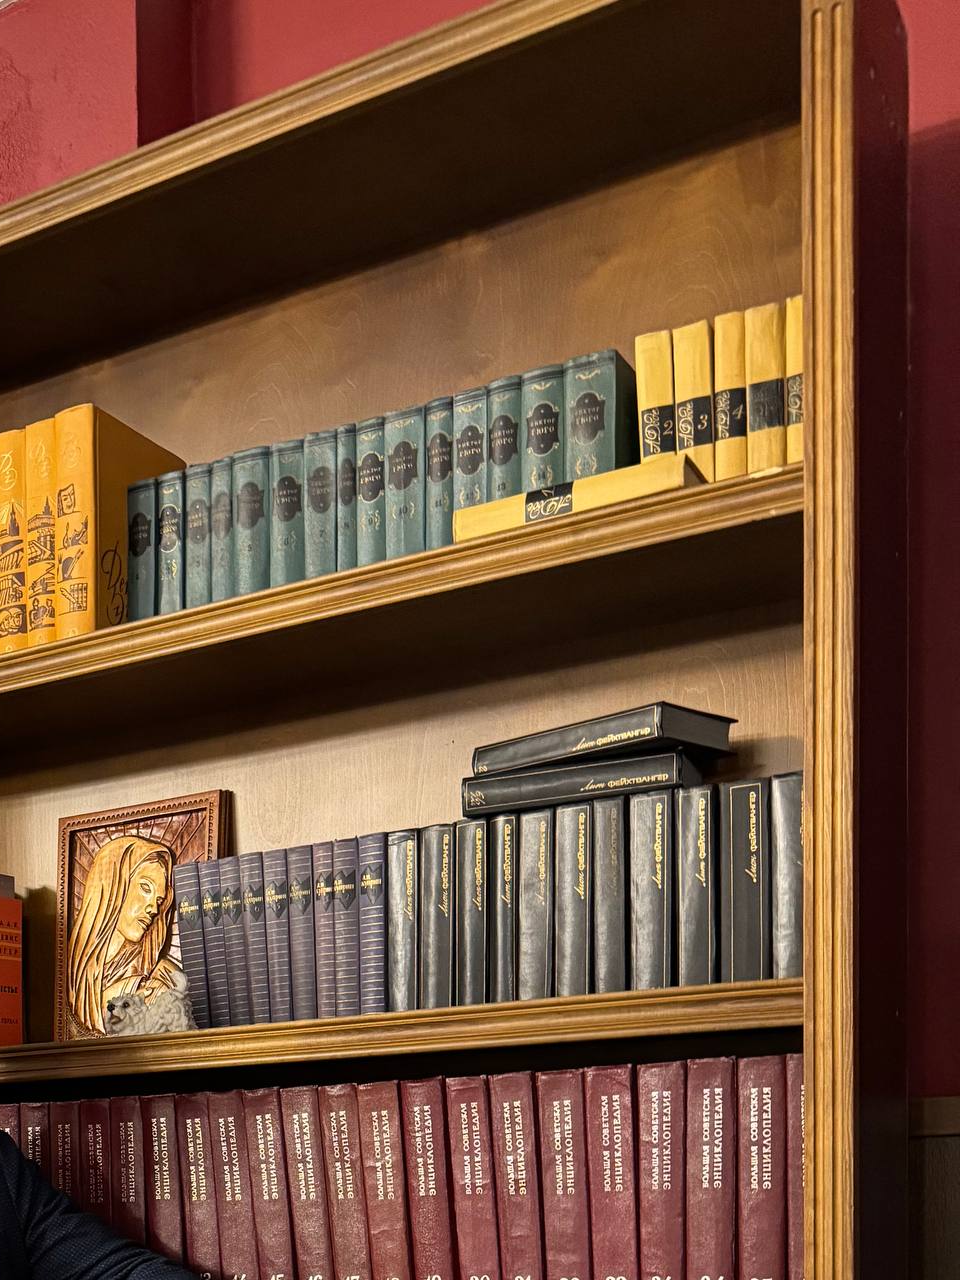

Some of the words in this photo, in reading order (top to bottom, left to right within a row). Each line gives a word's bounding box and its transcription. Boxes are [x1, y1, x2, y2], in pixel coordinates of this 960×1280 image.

[663, 420, 673, 436] 2
[697, 414, 708, 430] 3
[732, 404, 744, 419] 4
[596, 727, 651, 746] ФЕЙХТВАНГЕР
[607, 773, 669, 788] ФЕЙХТВАНГЕР
[577, 812, 585, 871] ФЕЙХТВАНГЕР
[654, 802, 663, 863] ФЕЙХТВАНГЕР
[697, 797, 706, 859] ФЕЙХТВАНГЕР
[748, 791, 758, 852] ФЕЙХТВАНГЕР
[255, 1115, 266, 1159] СОВЕТСКАЯ
[292, 1114, 303, 1160] СОВЕТСКАЯ
[329, 1111, 340, 1158] СОВЕТСКАЯ
[371, 1111, 380, 1158] СОВЕТСКАЯ
[413, 1106, 423, 1154] СОВЕТСКАЯ
[460, 1102, 470, 1152] СОВЕТСКАЯ
[503, 1102, 513, 1151] СОВЕТСКАЯ
[553, 1101, 562, 1151] СОВЕТСКАЯ
[601, 1095, 610, 1147] СОВЕТСКАЯ
[651, 1091, 659, 1144] СОВЕТСКАЯ
[702, 1088, 710, 1142] СОВЕТСКАЯ
[713, 1087, 723, 1189] ЭНЦИКЛОПЕДИЯ
[750, 1087, 759, 1142] СОВЕТСКАЯ
[762, 1087, 772, 1189] ЭНЦИКЛОПЕДИЯ
[151, 1118, 159, 1162] СОВЕТСКАЯ
[160, 1117, 171, 1200] ЭНЦИКЛОПЕДИЯ
[185, 1119, 195, 1162] СОВЕТСКАЯ
[194, 1118, 207, 1201] ЭНЦИКЛОПЕДИЯ
[218, 1118, 229, 1162] СОВЕТСКАЯ
[227, 1116, 241, 1201] ЭНЦИКЛОПЕДИЯ
[264, 1113, 279, 1200] ЭНЦИКЛОПЕДИЯ
[301, 1112, 316, 1200] ЭНЦИКЛОПЕДИЯ
[339, 1110, 354, 1199] ЭНЦИКЛОПЕДИЯ
[381, 1110, 395, 1200] ЭНЦИКЛОПЕДИЯ
[423, 1105, 436, 1196] ЭНЦИКЛОПЕДИЯ
[470, 1102, 483, 1195] ЭНЦИКЛОПЕДИЯ
[513, 1100, 527, 1195] ЭНЦИКЛОПЕДИЯ
[563, 1100, 575, 1195] ЭНЦИКЛОПЕДИЯ
[612, 1094, 623, 1192] ЭНЦИКЛОПЕДИЯ
[662, 1090, 672, 1190] ЭНЦИКЛОПЕДИЯ
[190, 1165, 198, 1201] БОЛЬШАЯ
[223, 1165, 232, 1201] БОЛЬШАЯ
[260, 1163, 270, 1200] БОЛЬШАЯ
[297, 1162, 306, 1200] БОЛЬШАЯ
[335, 1161, 344, 1200] БОЛЬШАЯ
[375, 1162, 384, 1200] БОЛЬШАЯ
[417, 1157, 426, 1197] БОЛЬШАЯ
[463, 1155, 472, 1195] БОЛЬШАЯ
[506, 1155, 515, 1195] БОЛЬШАЯ
[555, 1154, 563, 1195] БОЛЬШАЯ
[602, 1150, 611, 1192] БОЛЬШАЯ
[651, 1147, 659, 1190] БОЛЬШАЯ
[702, 1145, 710, 1188] БОЛЬШАЯ
[750, 1145, 759, 1190] БОЛЬШАЯ
